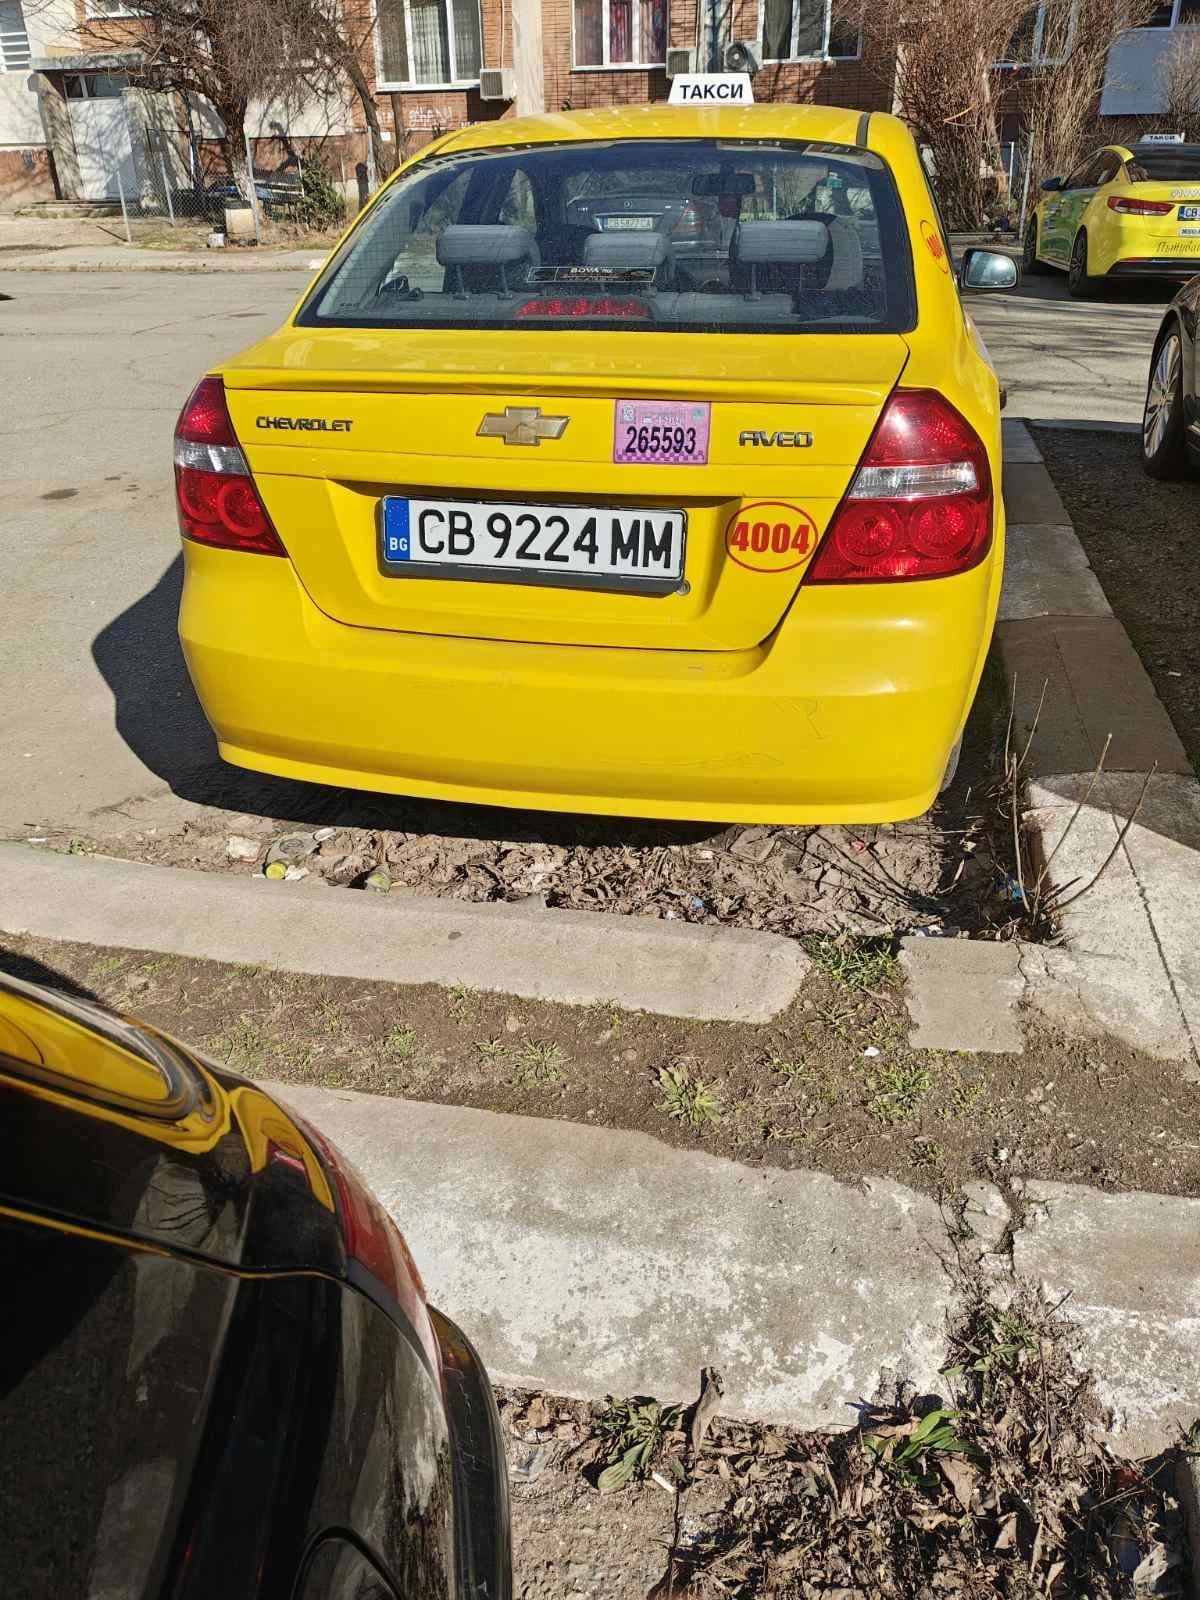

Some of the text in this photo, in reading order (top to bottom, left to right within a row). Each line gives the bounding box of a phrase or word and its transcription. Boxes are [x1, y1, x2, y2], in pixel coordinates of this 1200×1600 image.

[679, 83, 744, 100] ТАКСИ
[256, 416, 353, 431] CHEVROLET
[625, 426, 696, 454] 265593
[739, 431, 813, 447] AVEO
[389, 537, 408, 551] BG
[418, 509, 673, 569] CB 9224 MM
[731, 521, 810, 554] 4004
